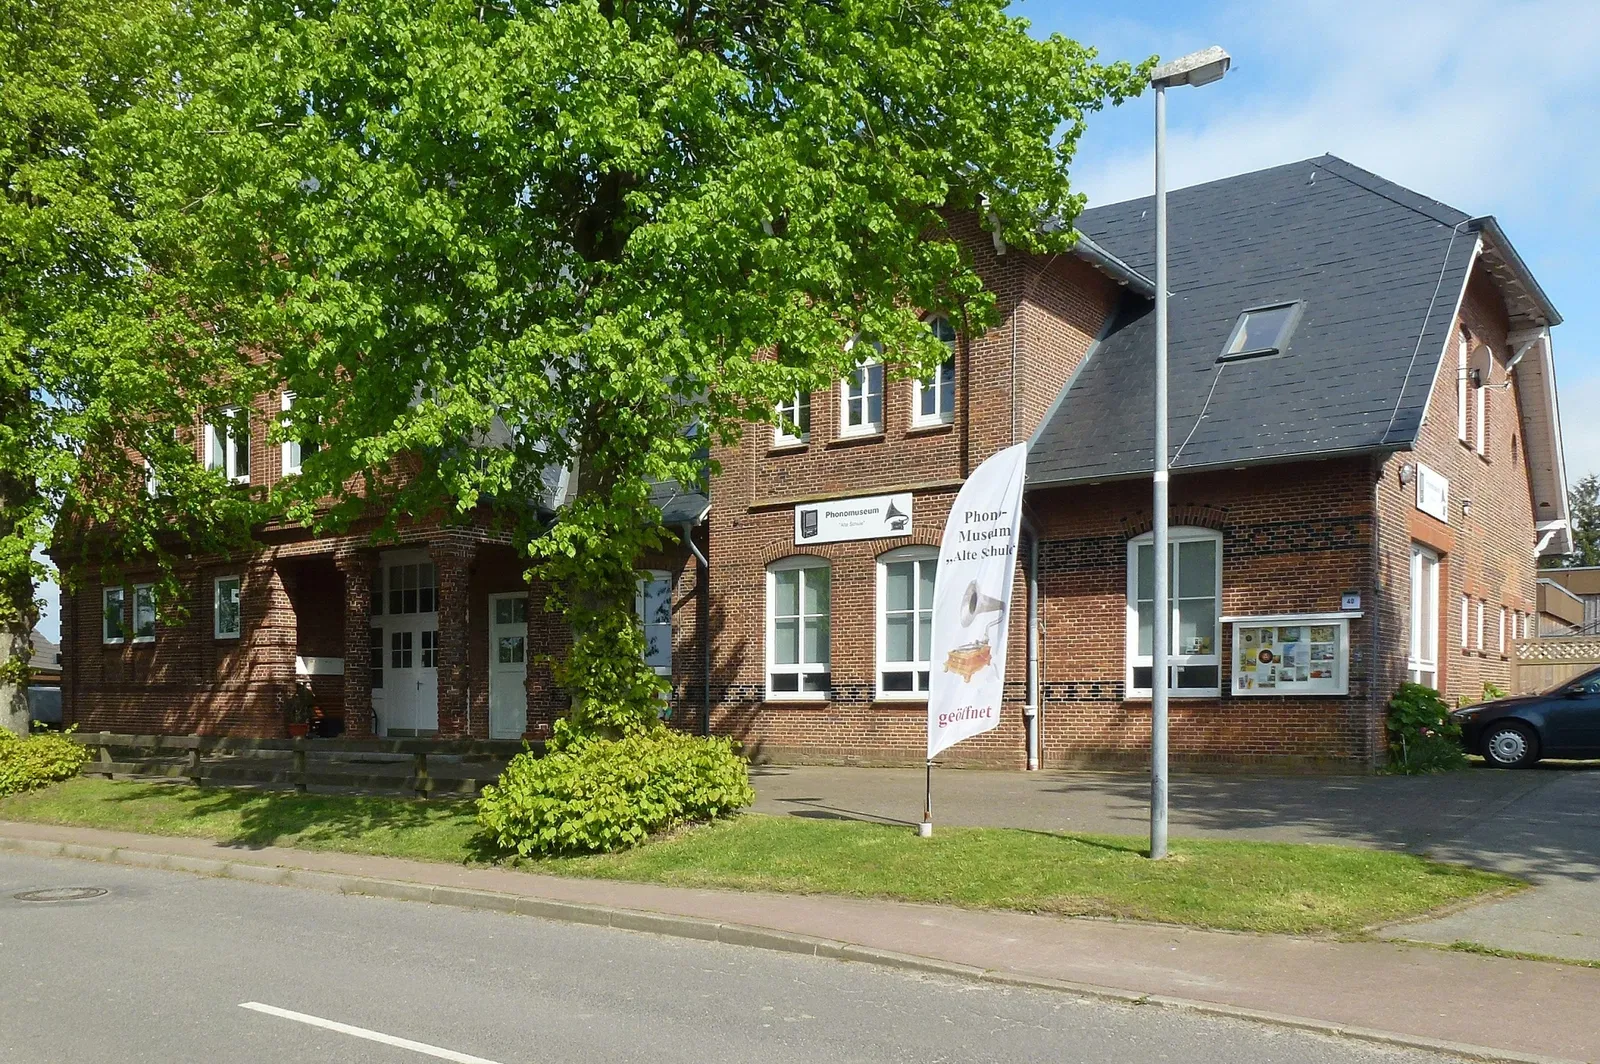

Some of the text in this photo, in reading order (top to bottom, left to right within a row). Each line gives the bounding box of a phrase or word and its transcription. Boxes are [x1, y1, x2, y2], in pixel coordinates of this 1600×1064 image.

[825, 507, 880, 518] Phonomuseum
[1346, 597, 1355, 605] 40
[938, 705, 992, 728] geöffnet
